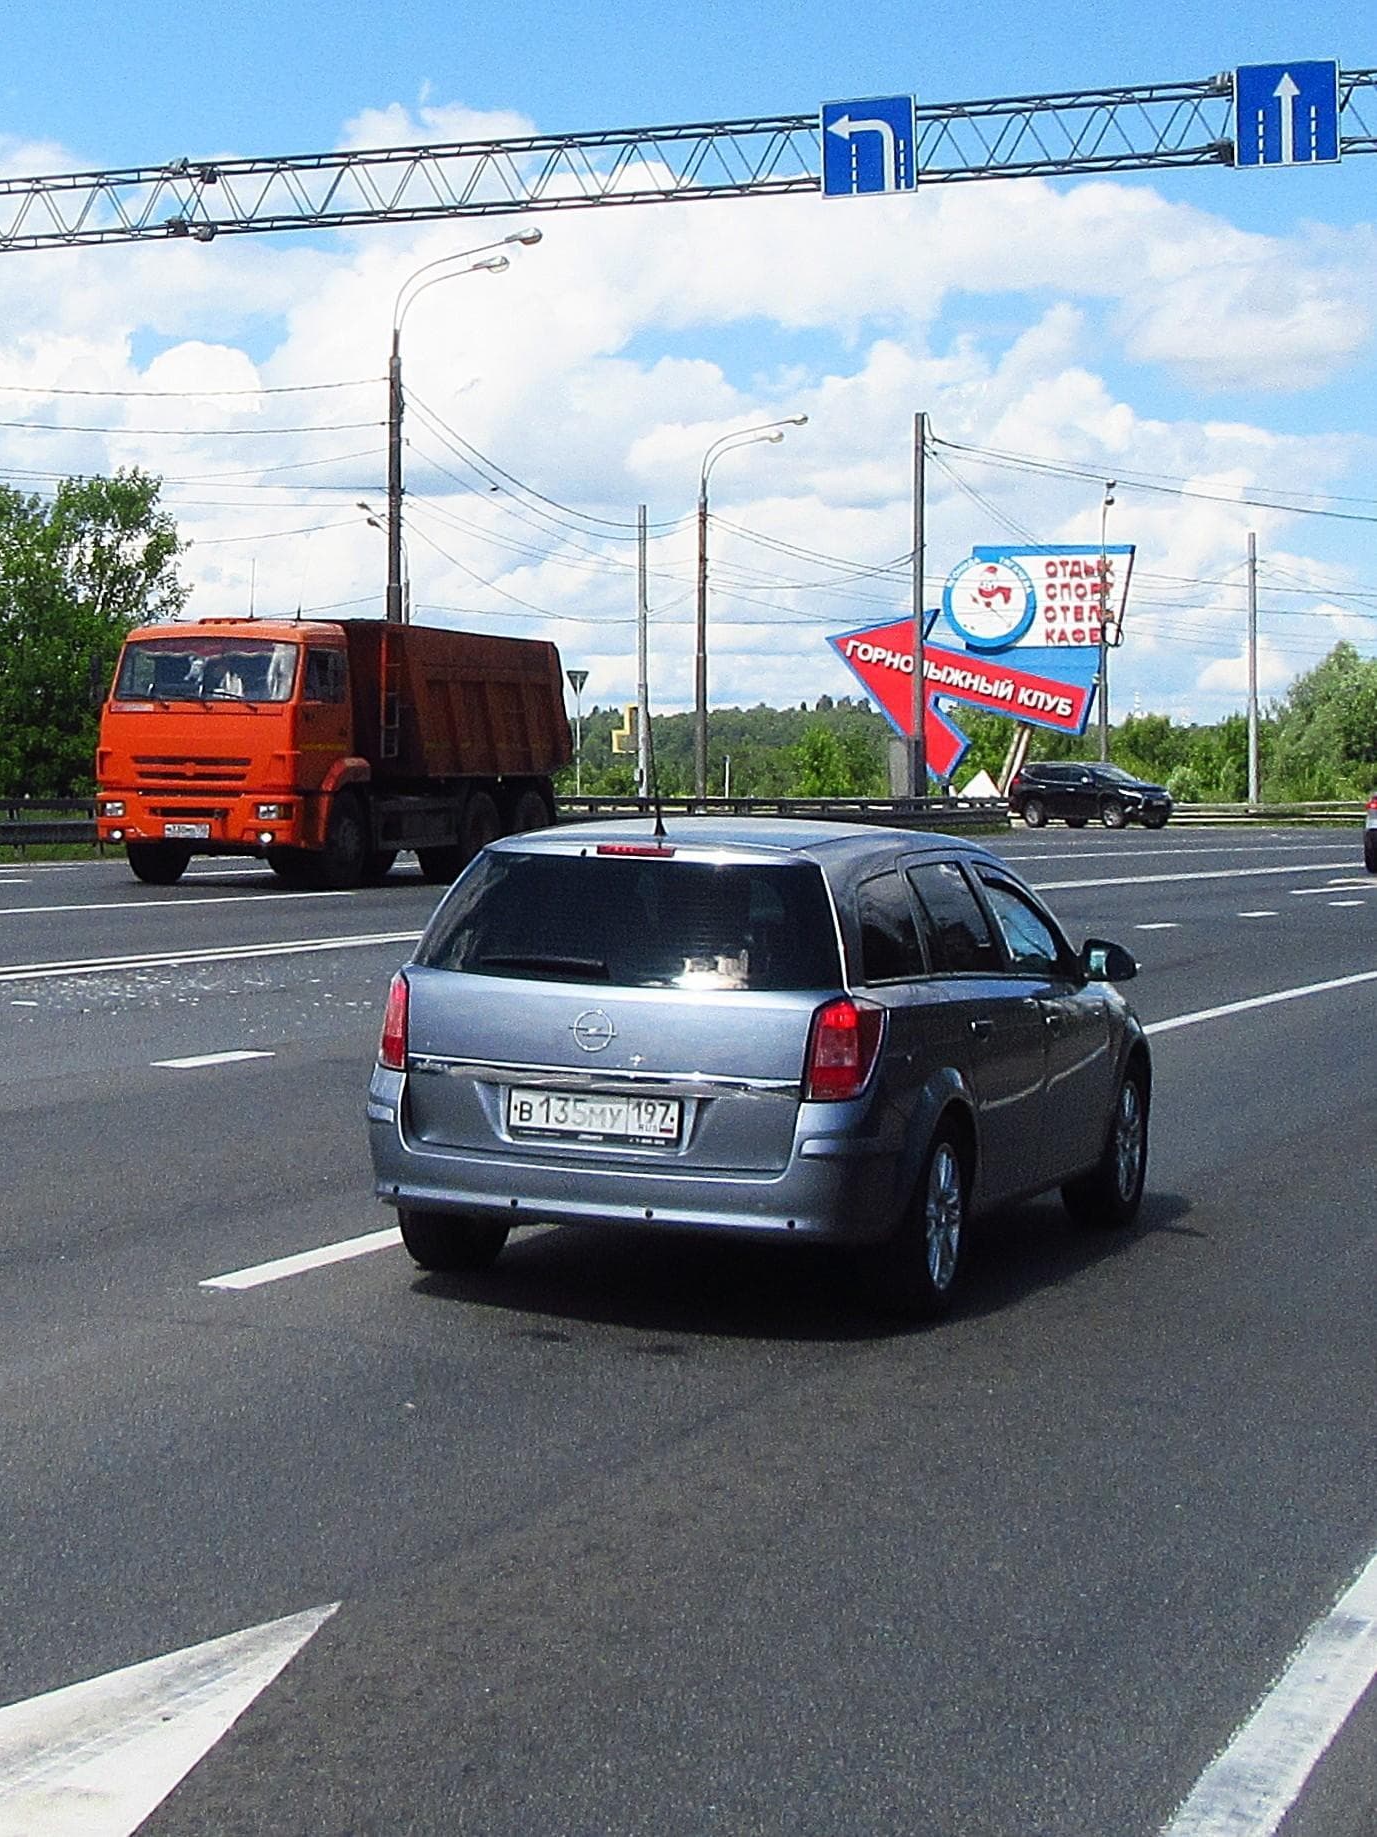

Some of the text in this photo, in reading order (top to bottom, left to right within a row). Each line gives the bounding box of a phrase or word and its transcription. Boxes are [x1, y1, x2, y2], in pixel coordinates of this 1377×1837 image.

[1045, 583, 1115, 600] СПОРТ
[1043, 605, 1110, 623] ОТЕЛ
[1045, 627, 1103, 644] КАФЕ
[1017, 687, 1073, 717] КЛУБ
[631, 1101, 672, 1124] 197
